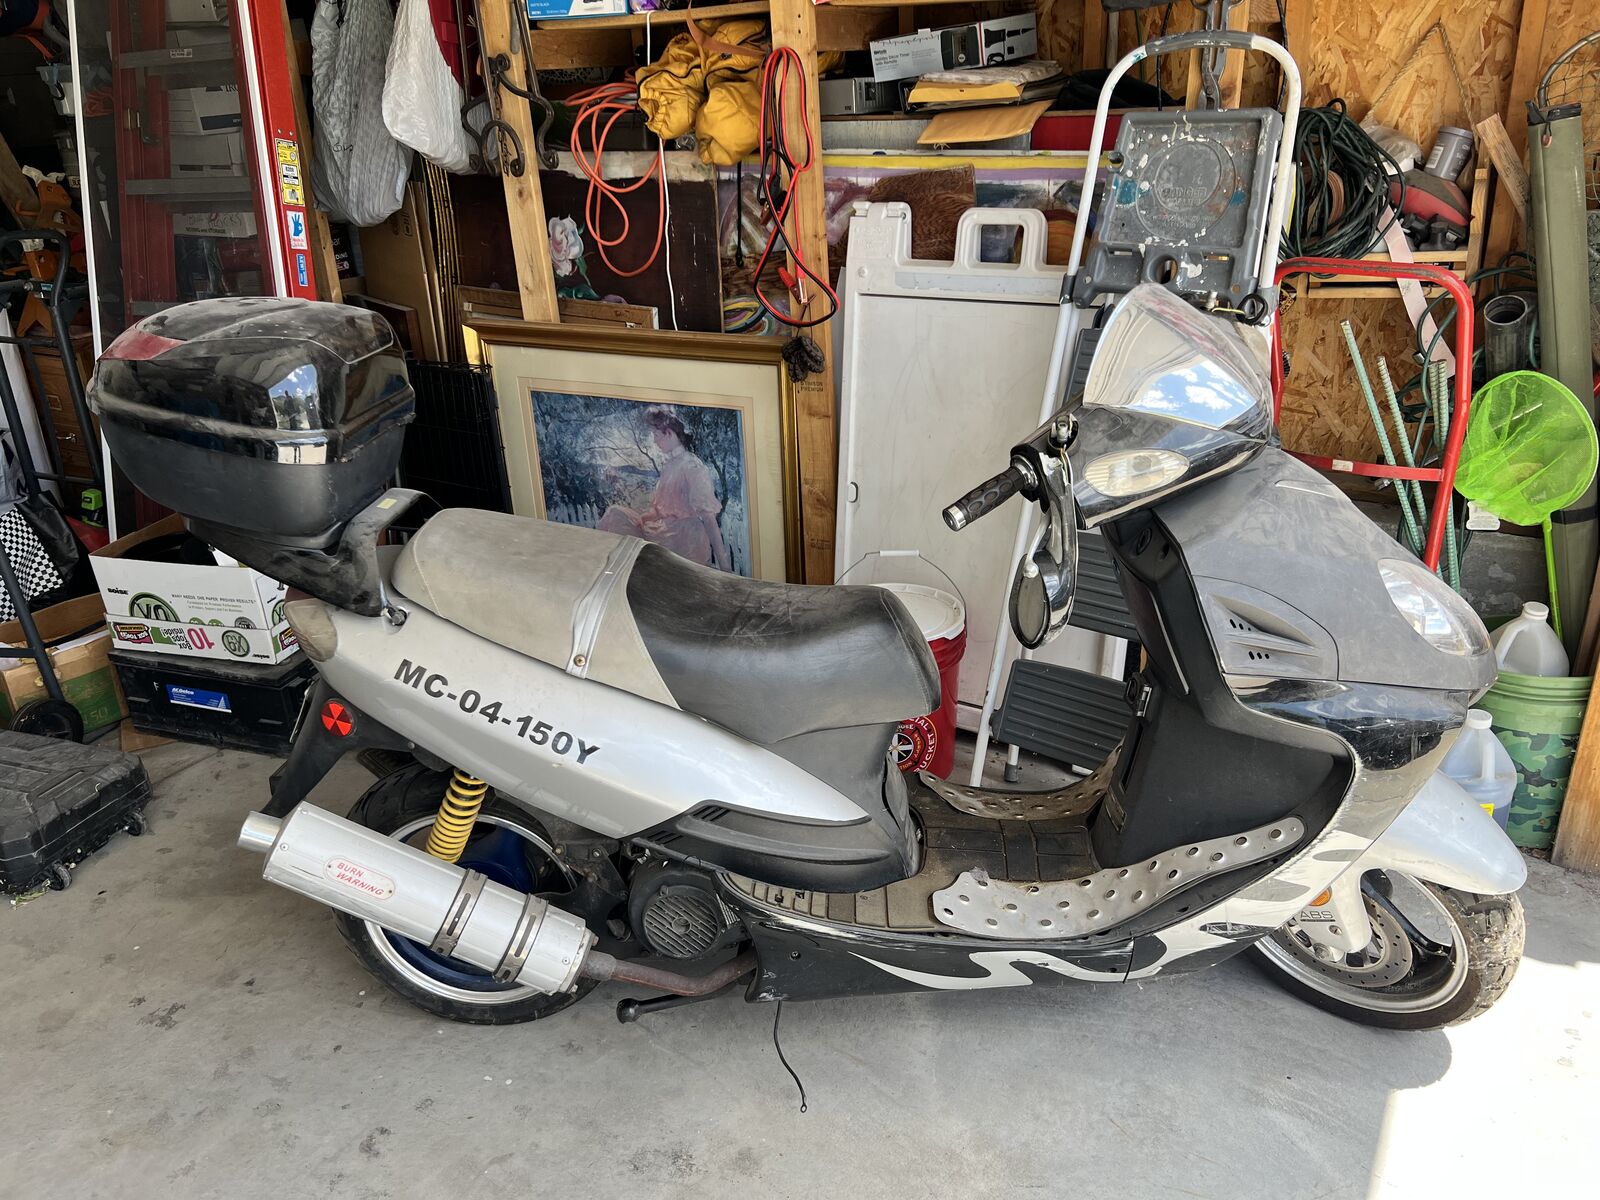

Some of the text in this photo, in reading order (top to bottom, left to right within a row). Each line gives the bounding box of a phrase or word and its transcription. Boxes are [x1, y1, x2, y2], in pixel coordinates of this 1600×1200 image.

[187, 627, 215, 650] 10
[393, 658, 601, 765] MC-04-150Y
[336, 861, 365, 878] BURN
[336, 871, 385, 896] WARNING
[1300, 910, 1334, 919] ABS
